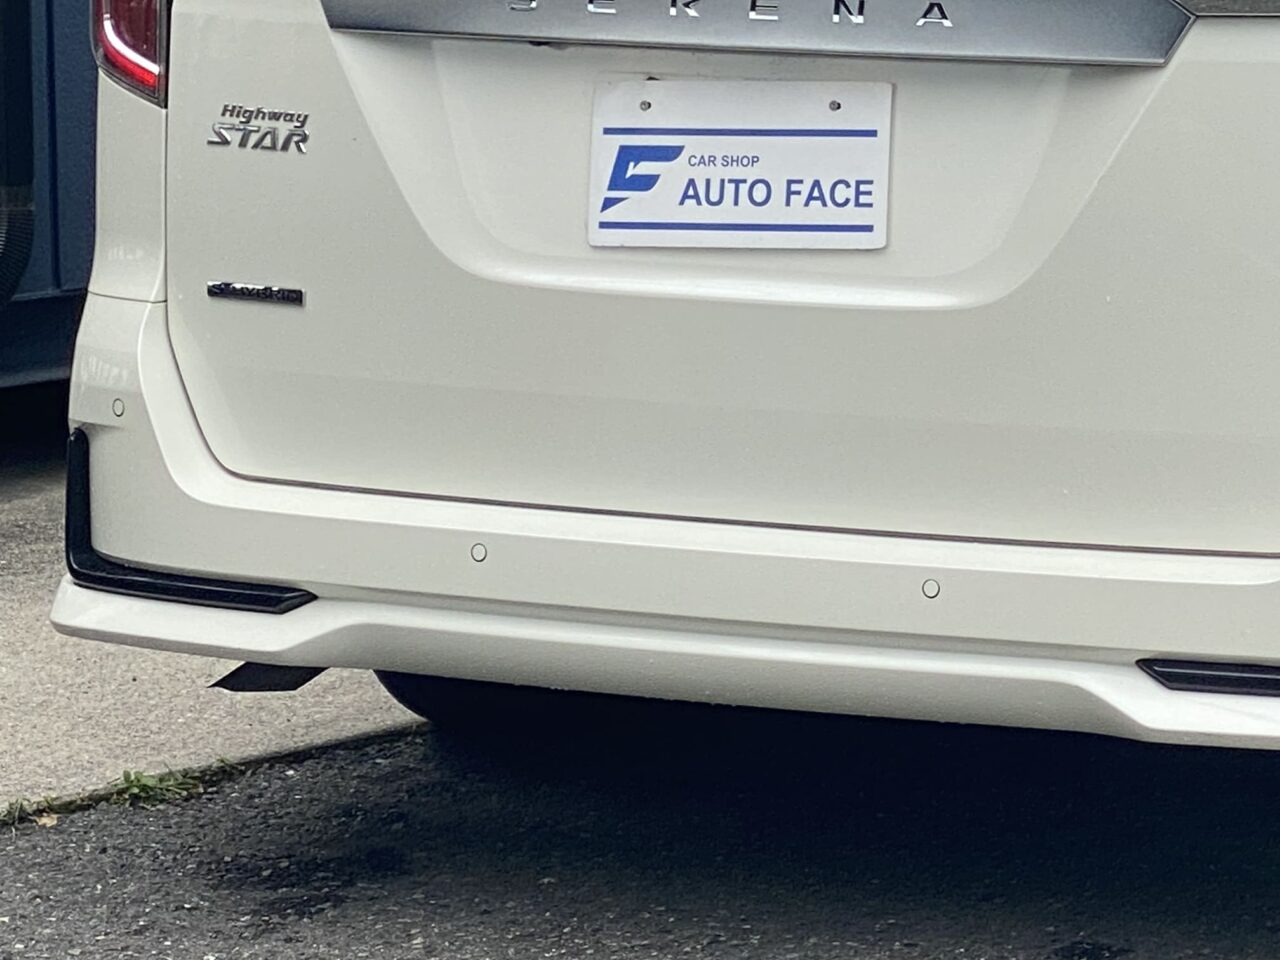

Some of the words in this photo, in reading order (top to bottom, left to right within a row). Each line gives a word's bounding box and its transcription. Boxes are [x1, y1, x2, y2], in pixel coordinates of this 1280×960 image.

[220, 103, 310, 129] Highway
[206, 122, 310, 155] STAR
[687, 154, 718, 168] CAR
[720, 154, 760, 169] SHOP
[678, 177, 773, 208] AUTO
[784, 178, 875, 209] FACE
